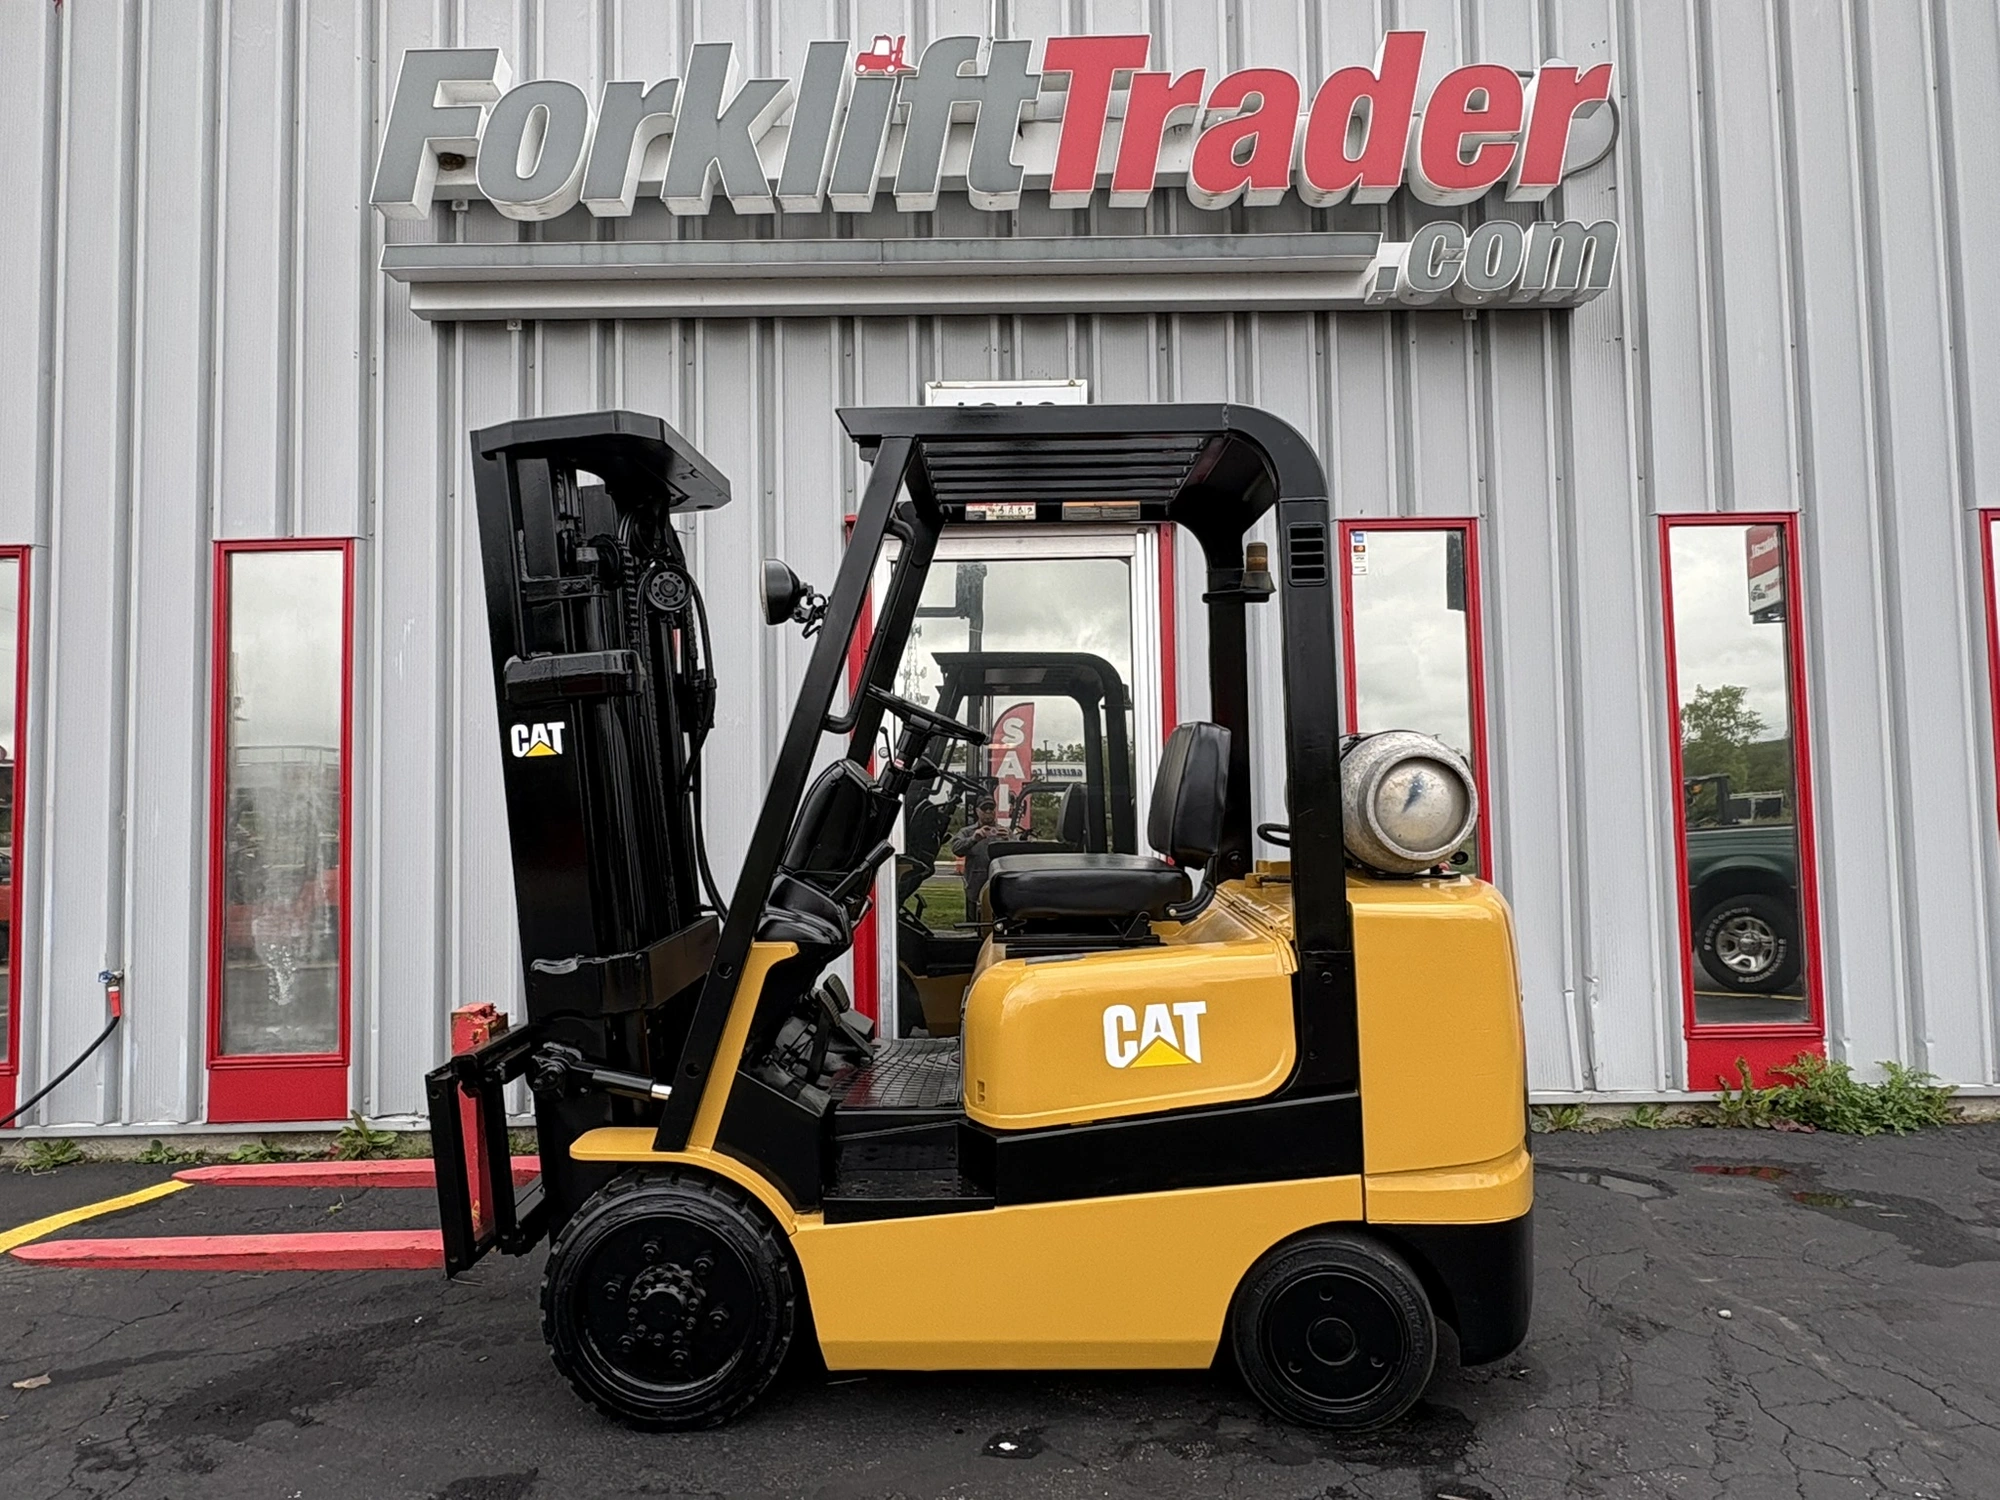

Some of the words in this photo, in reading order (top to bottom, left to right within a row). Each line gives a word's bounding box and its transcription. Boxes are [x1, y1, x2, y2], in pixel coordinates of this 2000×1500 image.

[1373, 218, 1621, 296] .com
[510, 721, 566, 758] CAT
[1102, 1000, 1207, 1069] CAT
